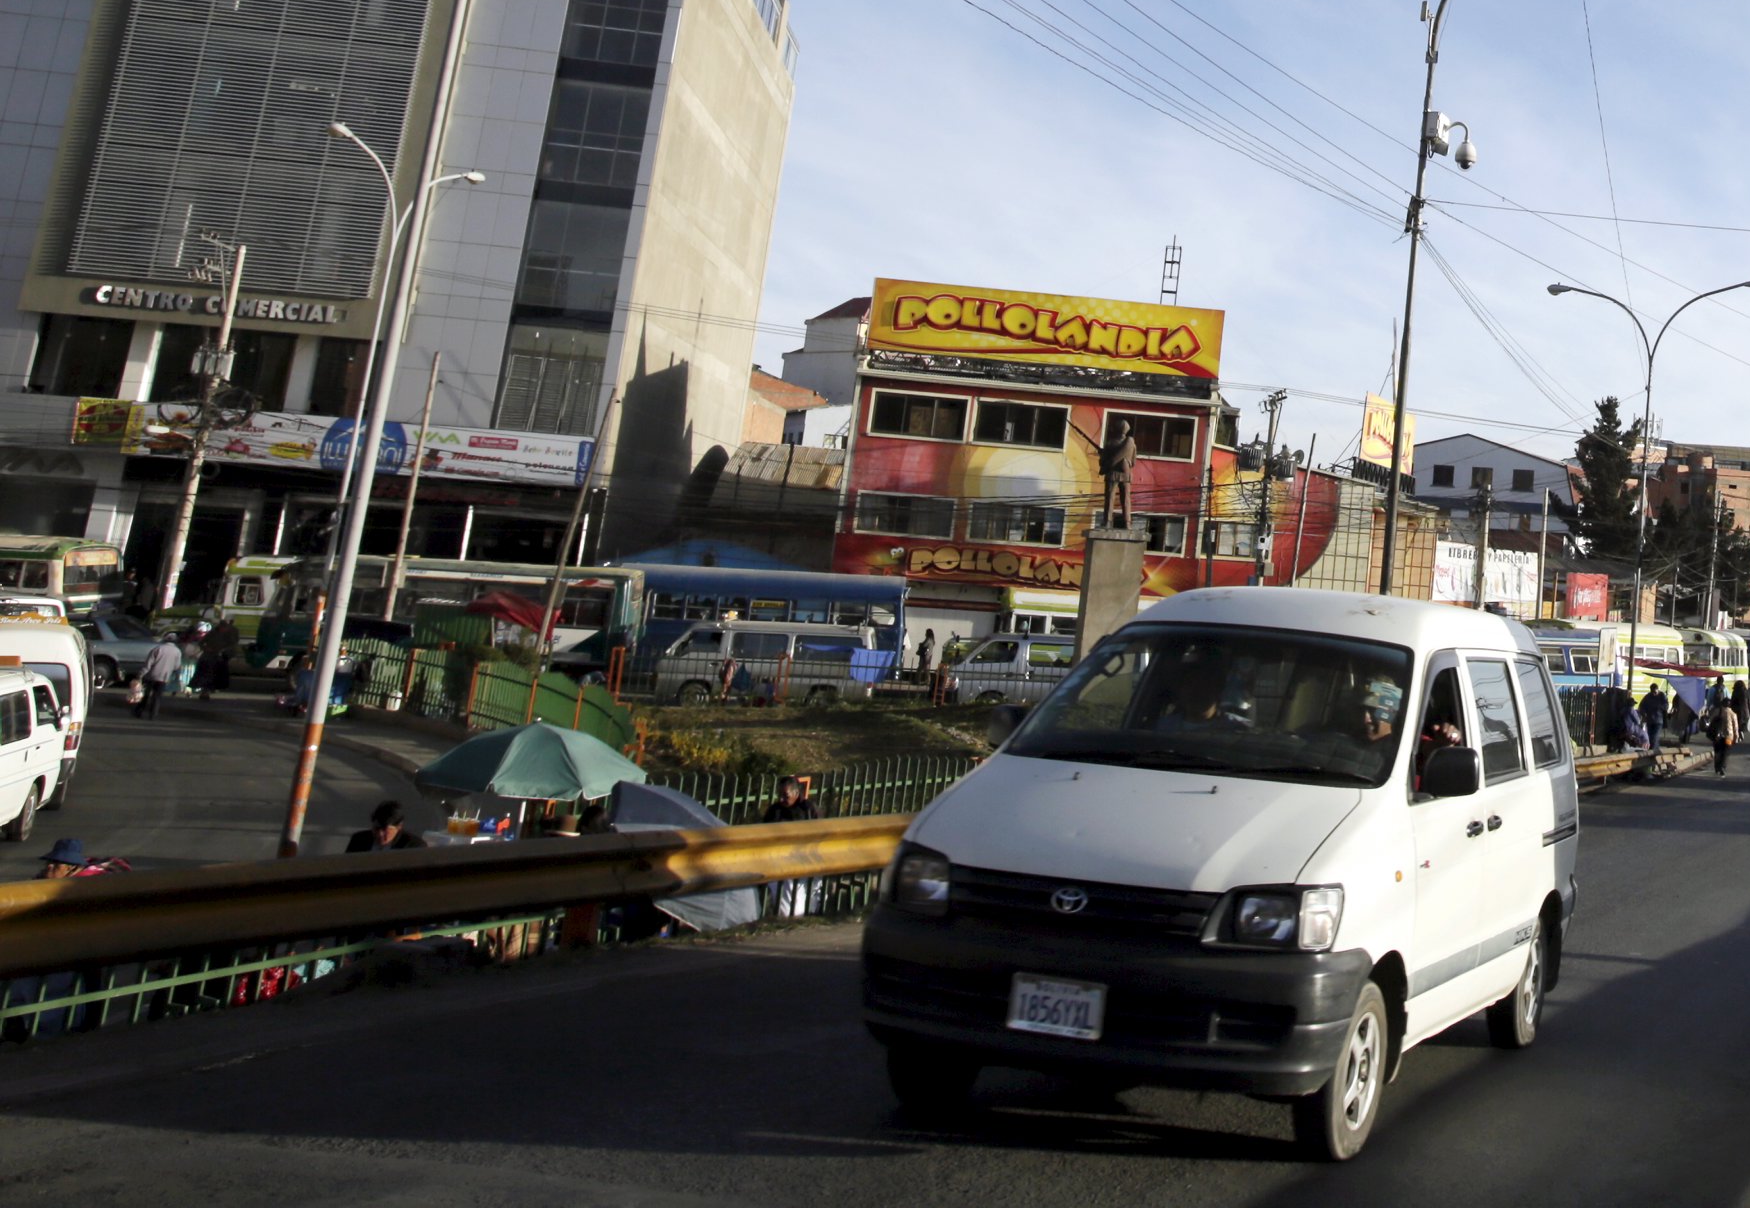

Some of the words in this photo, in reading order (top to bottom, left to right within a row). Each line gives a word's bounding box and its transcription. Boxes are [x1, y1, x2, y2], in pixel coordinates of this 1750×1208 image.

[96, 284, 194, 312] CENTRO
[206, 294, 337, 324] CMERCIAL
[892, 293, 1202, 363] POLLOLANDIA
[906, 546, 1085, 588] POLLOLAN
[1018, 992, 1095, 1030] 1856YXL
